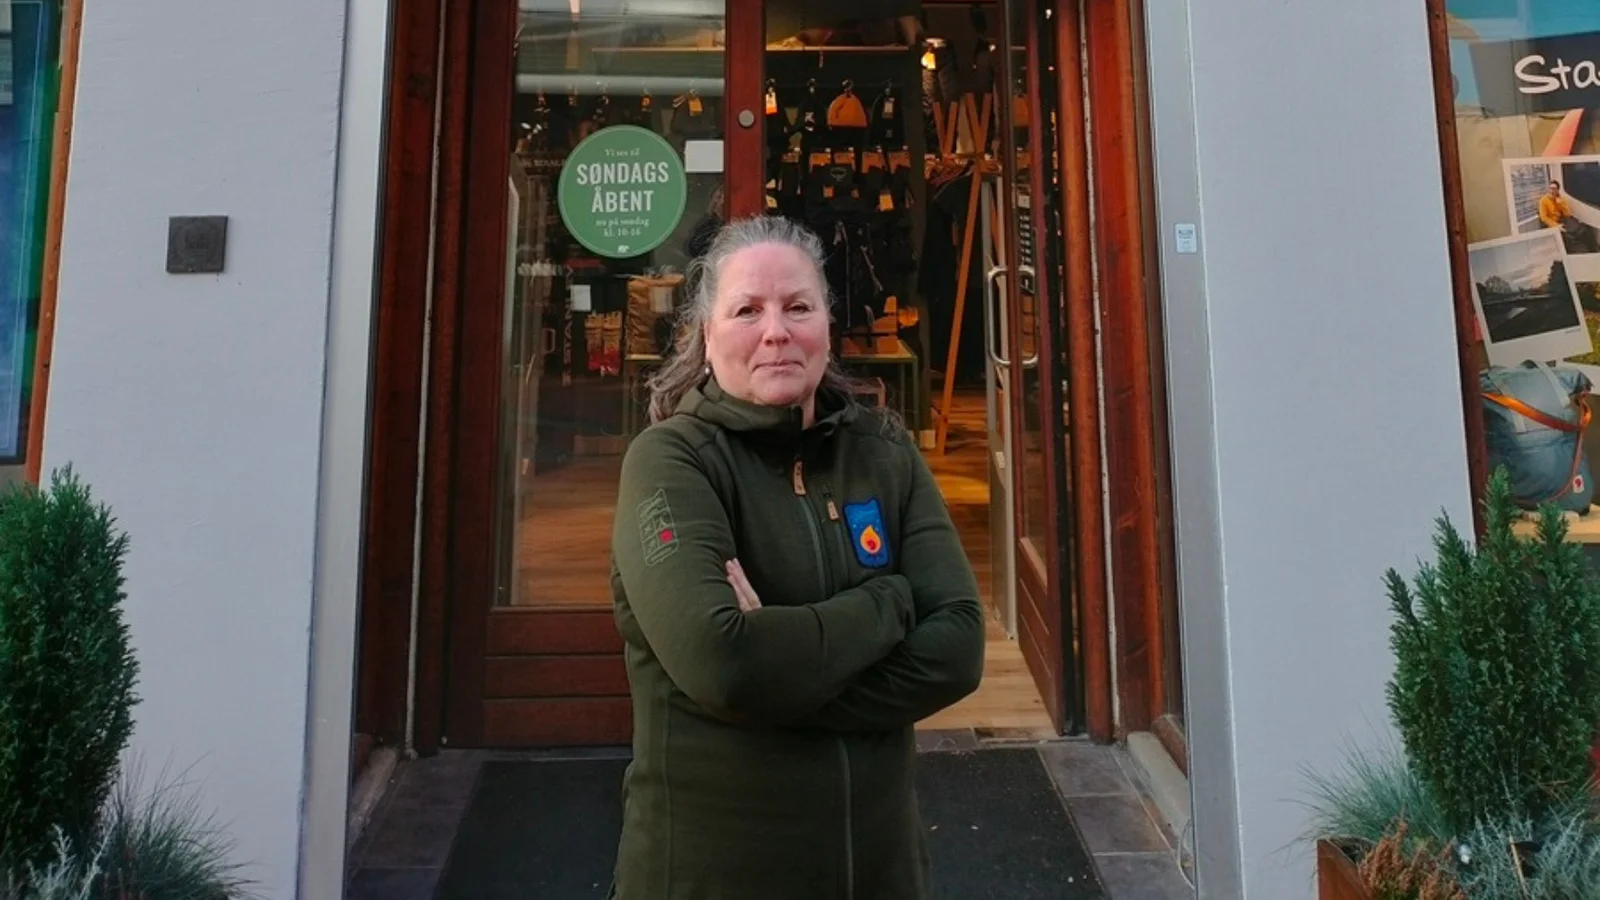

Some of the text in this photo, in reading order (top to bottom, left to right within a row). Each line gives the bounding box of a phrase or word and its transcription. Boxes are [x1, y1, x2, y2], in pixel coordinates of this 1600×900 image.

[604, 148, 615, 156] Vi
[577, 162, 669, 185] SØNDAGS
[592, 186, 654, 212] ÅBENT
